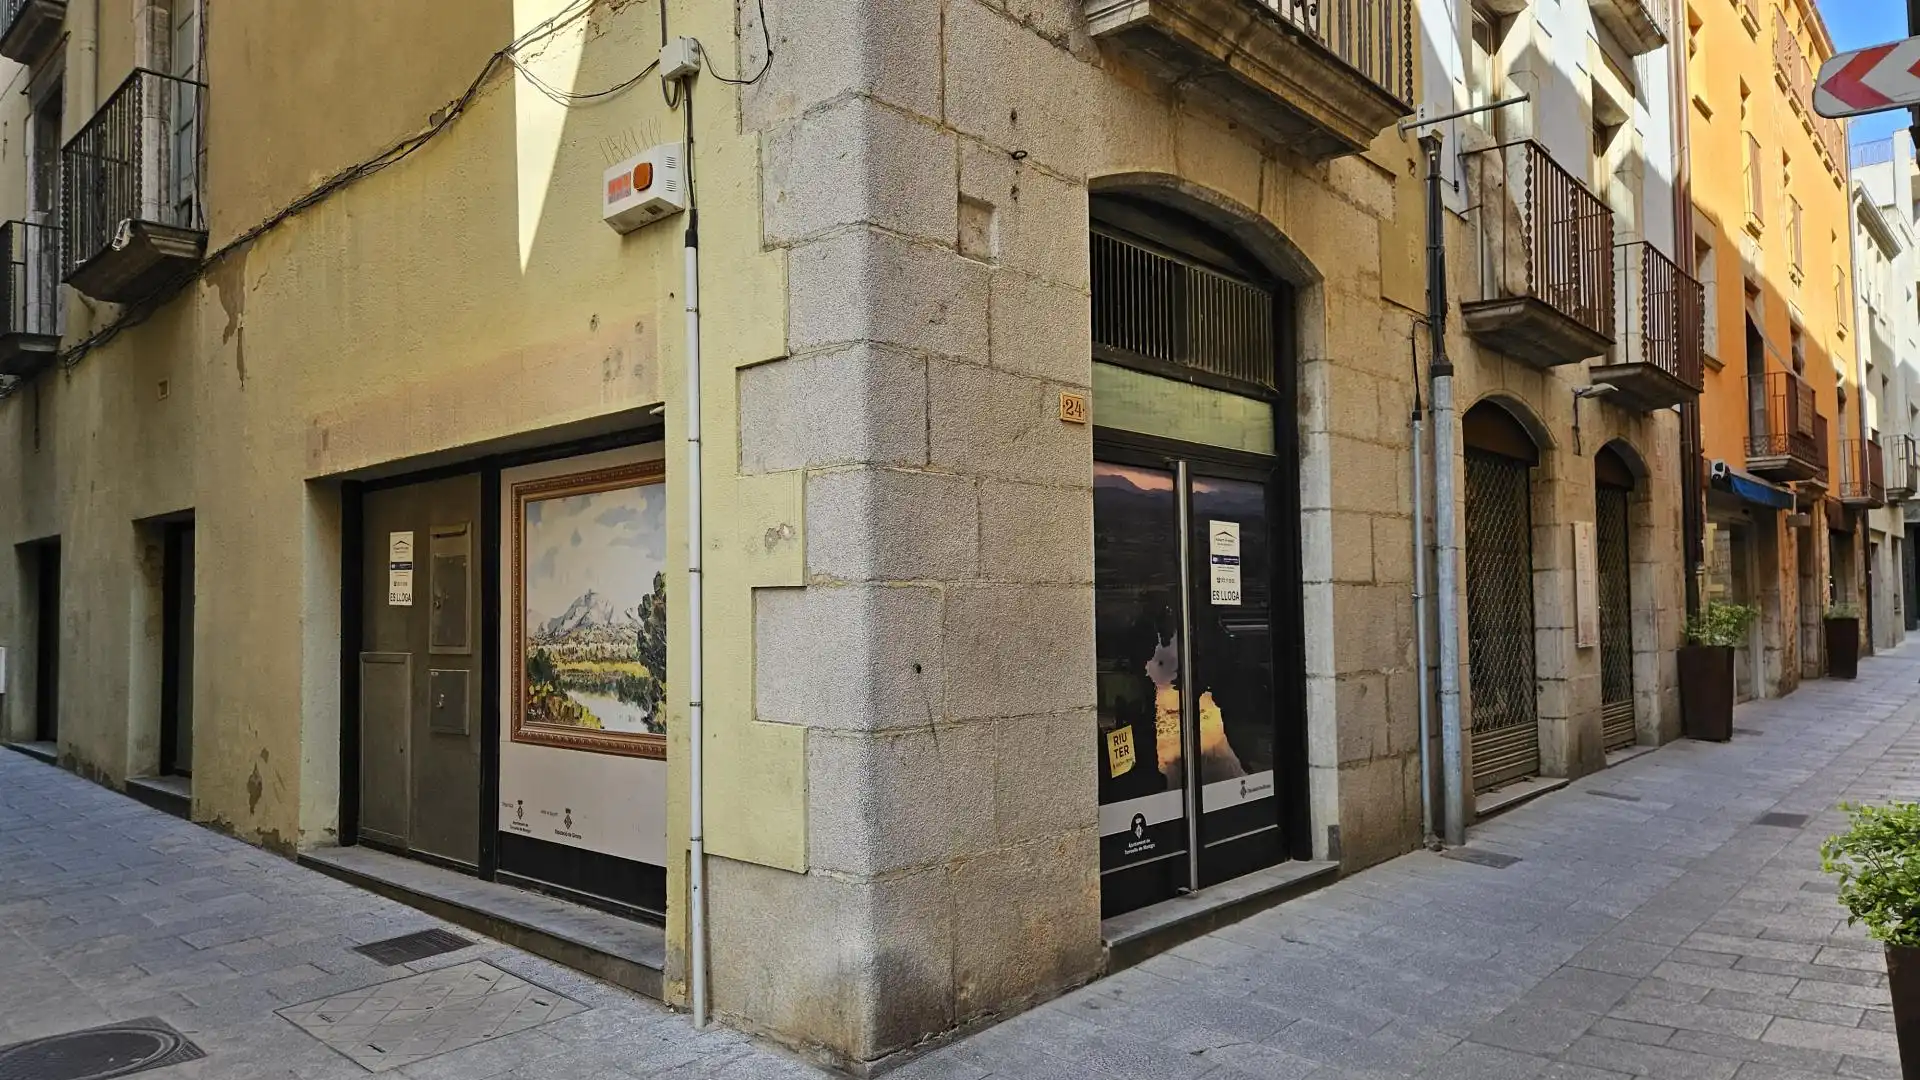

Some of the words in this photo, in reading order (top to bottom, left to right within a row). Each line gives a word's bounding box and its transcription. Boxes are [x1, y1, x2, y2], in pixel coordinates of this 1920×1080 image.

[390, 592, 396, 602] ES
[397, 592, 412, 602] LLOGA
[1212, 590, 1220, 601] ES
[1221, 590, 1240, 601] LLOGA
[1113, 731, 1128, 746] RIU
[1113, 744, 1130, 759] TER
